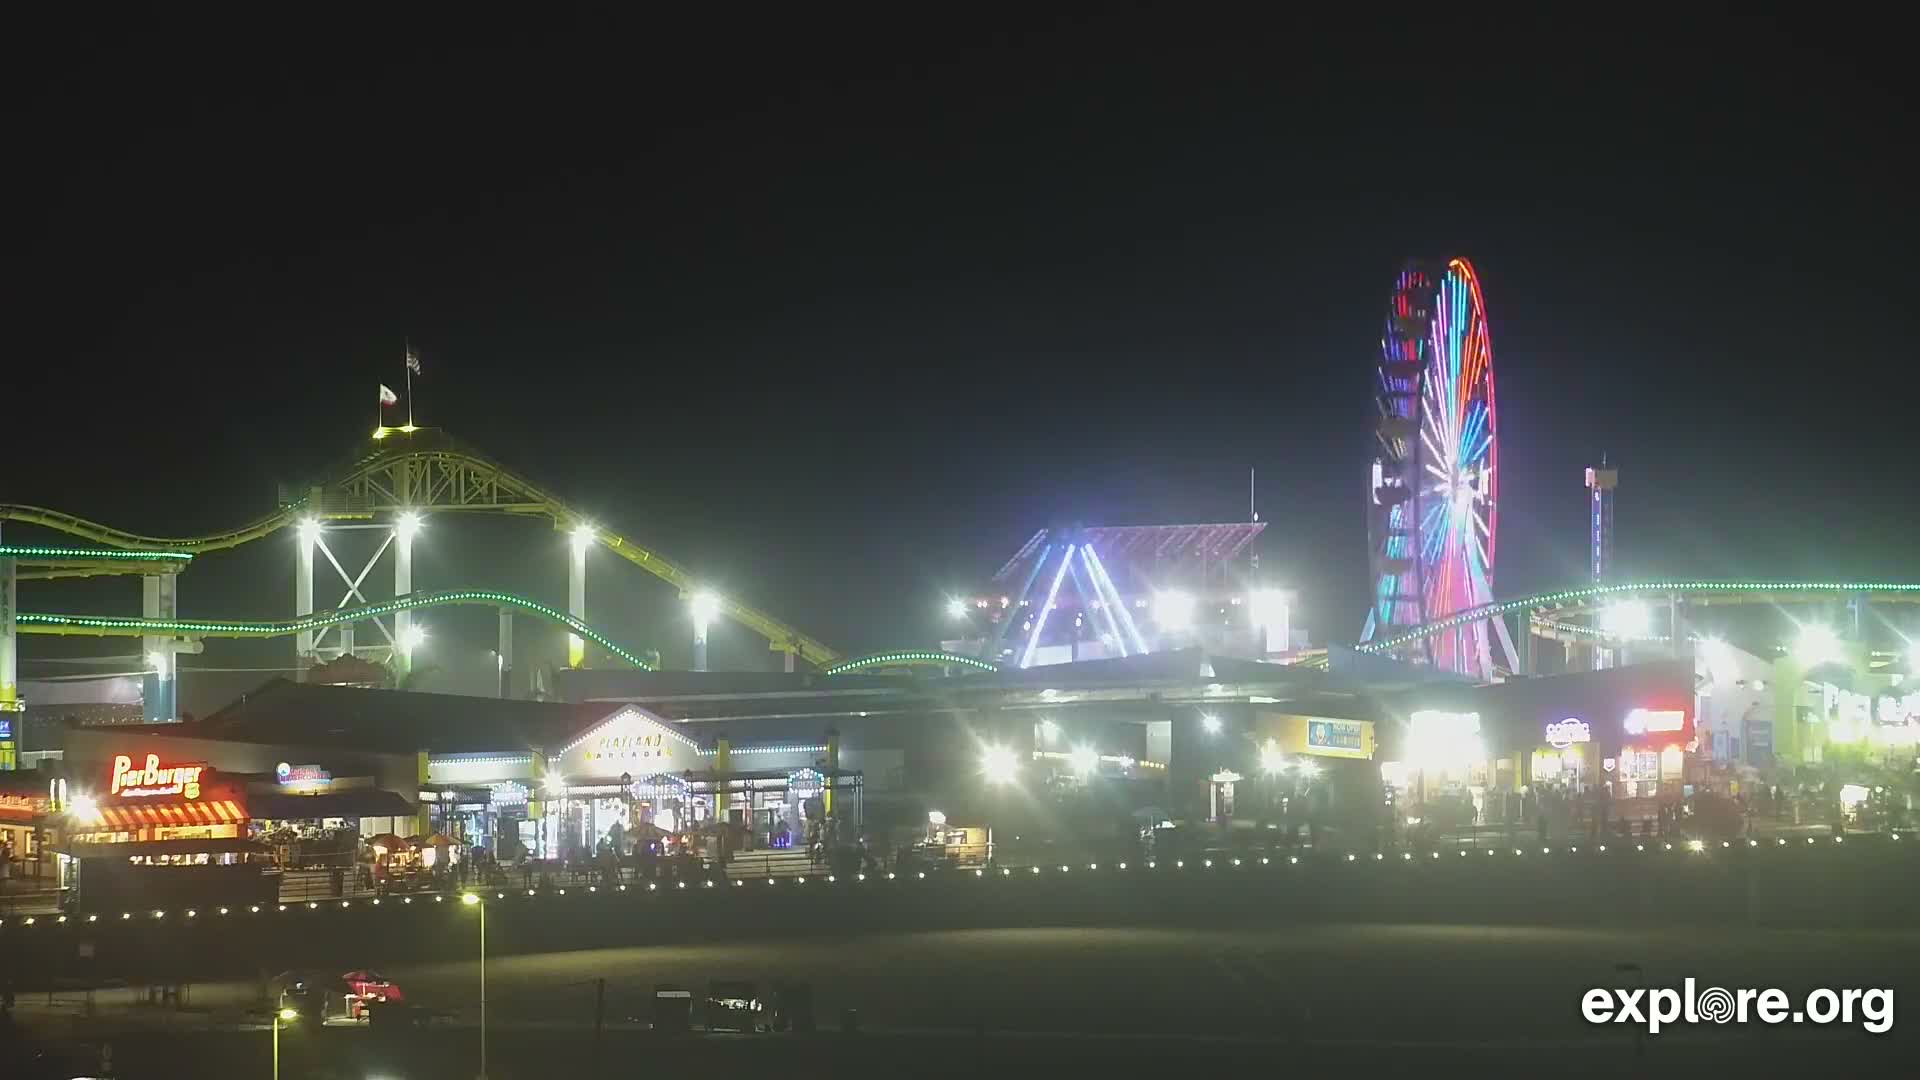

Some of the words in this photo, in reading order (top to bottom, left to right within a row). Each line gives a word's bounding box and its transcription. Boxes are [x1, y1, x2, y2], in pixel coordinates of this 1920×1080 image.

[600, 733, 661, 748] PLAYLAND
[596, 749, 662, 759] ARCADE
[111, 753, 202, 795] PierBurger
